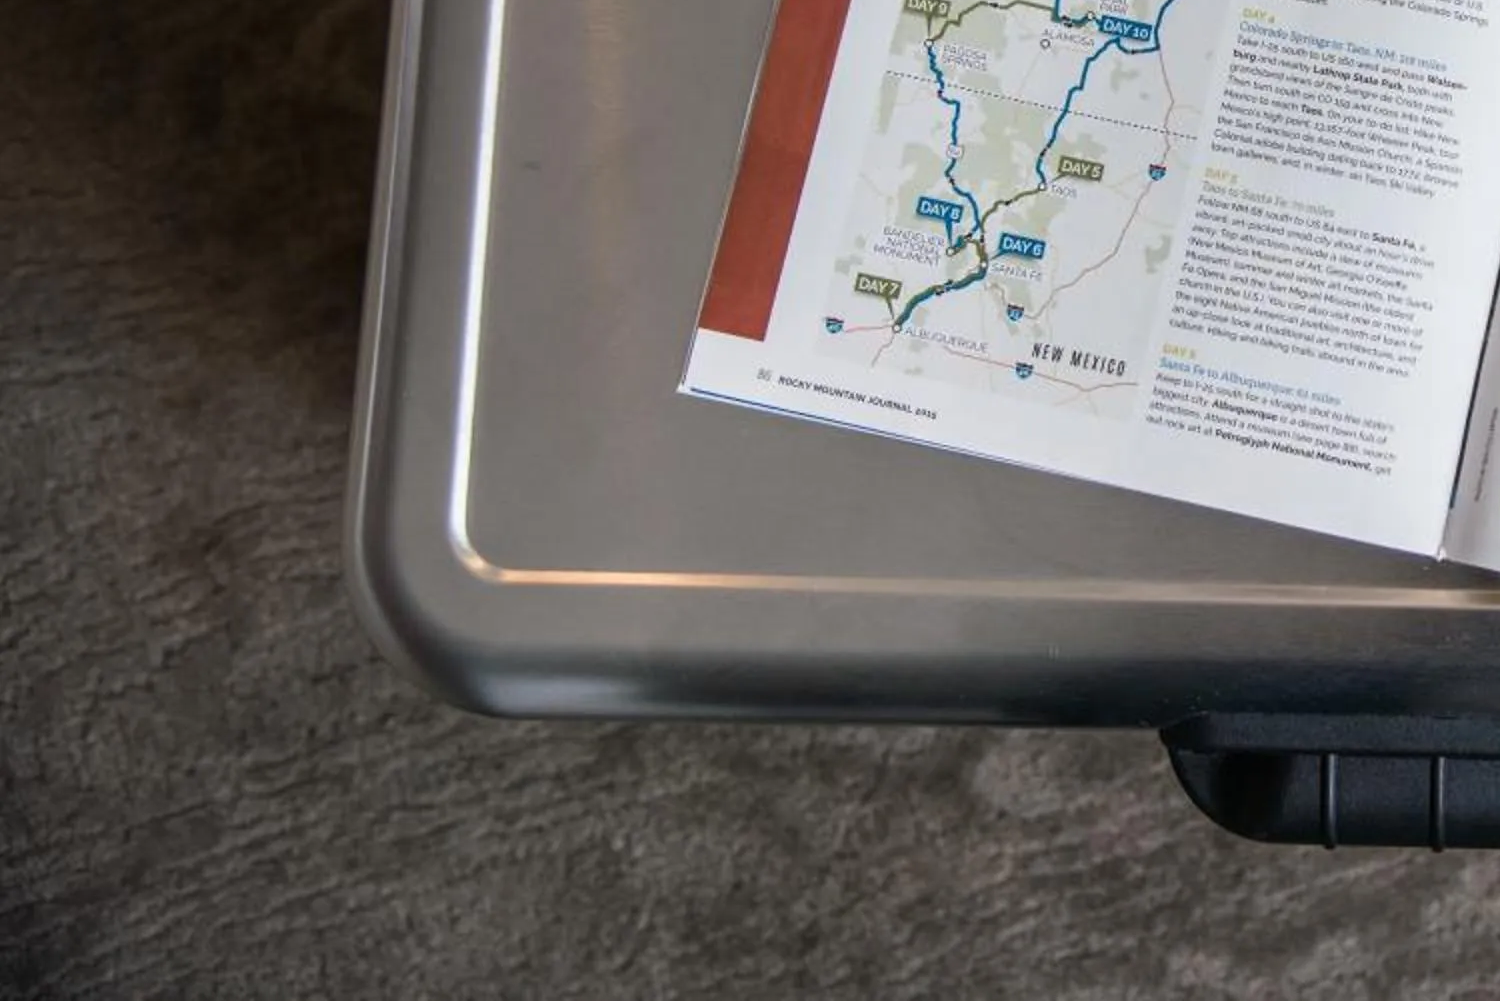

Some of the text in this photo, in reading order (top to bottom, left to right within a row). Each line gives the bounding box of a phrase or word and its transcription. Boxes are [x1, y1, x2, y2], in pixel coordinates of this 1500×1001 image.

[938, 3, 948, 14] 9
[1241, 7, 1266, 21] DAY
[1104, 19, 1149, 39] DAY 10
[1239, 20, 1288, 39] Colorado
[1288, 29, 1332, 50] Springs
[1416, 56, 1448, 72] miles
[1232, 48, 1257, 62] burg
[1259, 54, 1276, 64] and
[1277, 57, 1310, 73] nearby
[1312, 64, 1351, 82] Lathrop
[1352, 72, 1379, 86] State
[1061, 160, 1101, 178] DAY 5
[920, 201, 950, 217] DAY
[1227, 187, 1240, 198] to
[1304, 202, 1335, 218] miles
[1003, 237, 1043, 256] DAY 6
[1371, 231, 1401, 246] Santa
[990, 263, 1027, 278] SANTA
[858, 277, 898, 295] DAY 7
[905, 327, 989, 352] ALBUQUERQUE
[1031, 343, 1127, 377] NEW MEXICO
[1159, 355, 1191, 373] Santa
[1192, 363, 1206, 376] Fe
[1206, 367, 1219, 378] to
[777, 375, 812, 390] ROCKY
[812, 382, 866, 402] MOUNTAIN
[866, 395, 913, 414] JOURNAL
[1211, 399, 1278, 422] Albuquerque
[1214, 429, 1270, 450] Petroglyph
[1271, 441, 1314, 459] National
